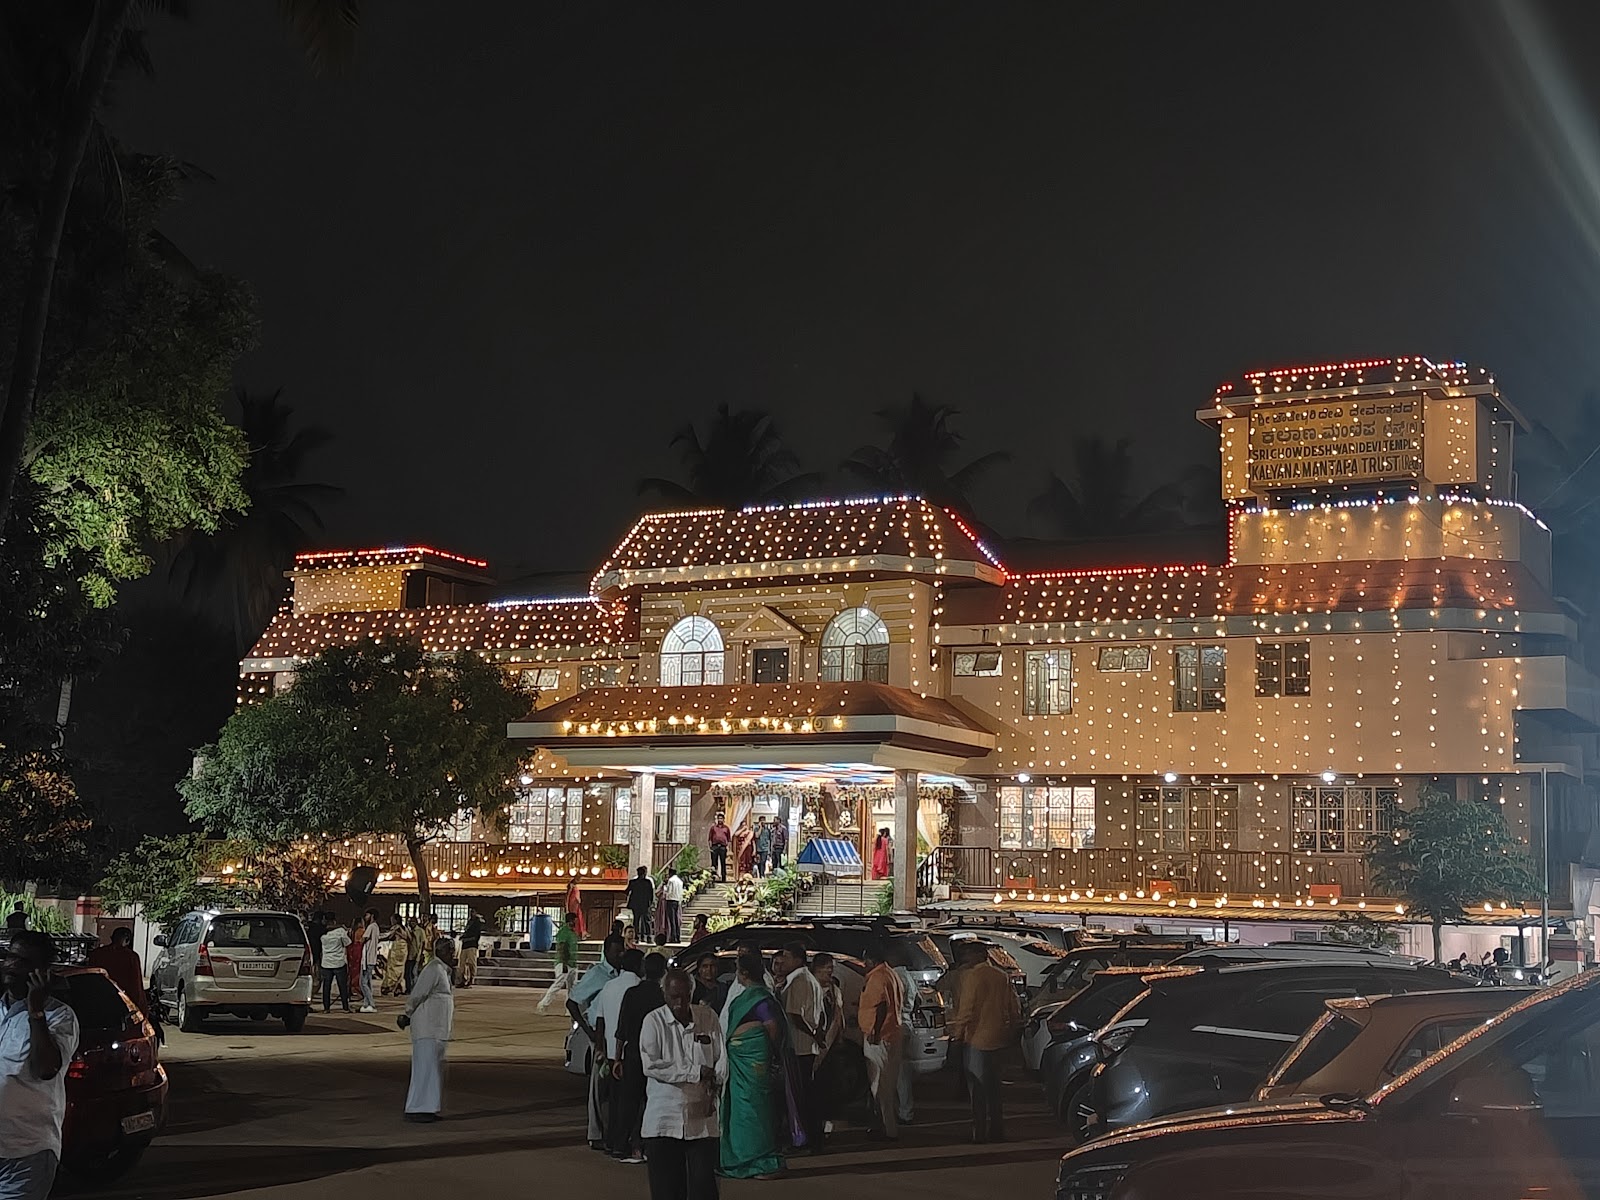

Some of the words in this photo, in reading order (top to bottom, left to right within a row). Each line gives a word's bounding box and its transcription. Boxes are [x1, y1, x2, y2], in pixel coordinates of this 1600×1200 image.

[1359, 440, 1381, 453] DEVI
[1252, 462, 1301, 480] KALYANA
[1302, 459, 1358, 478] MANTAPA
[1361, 456, 1400, 474] TRUST
